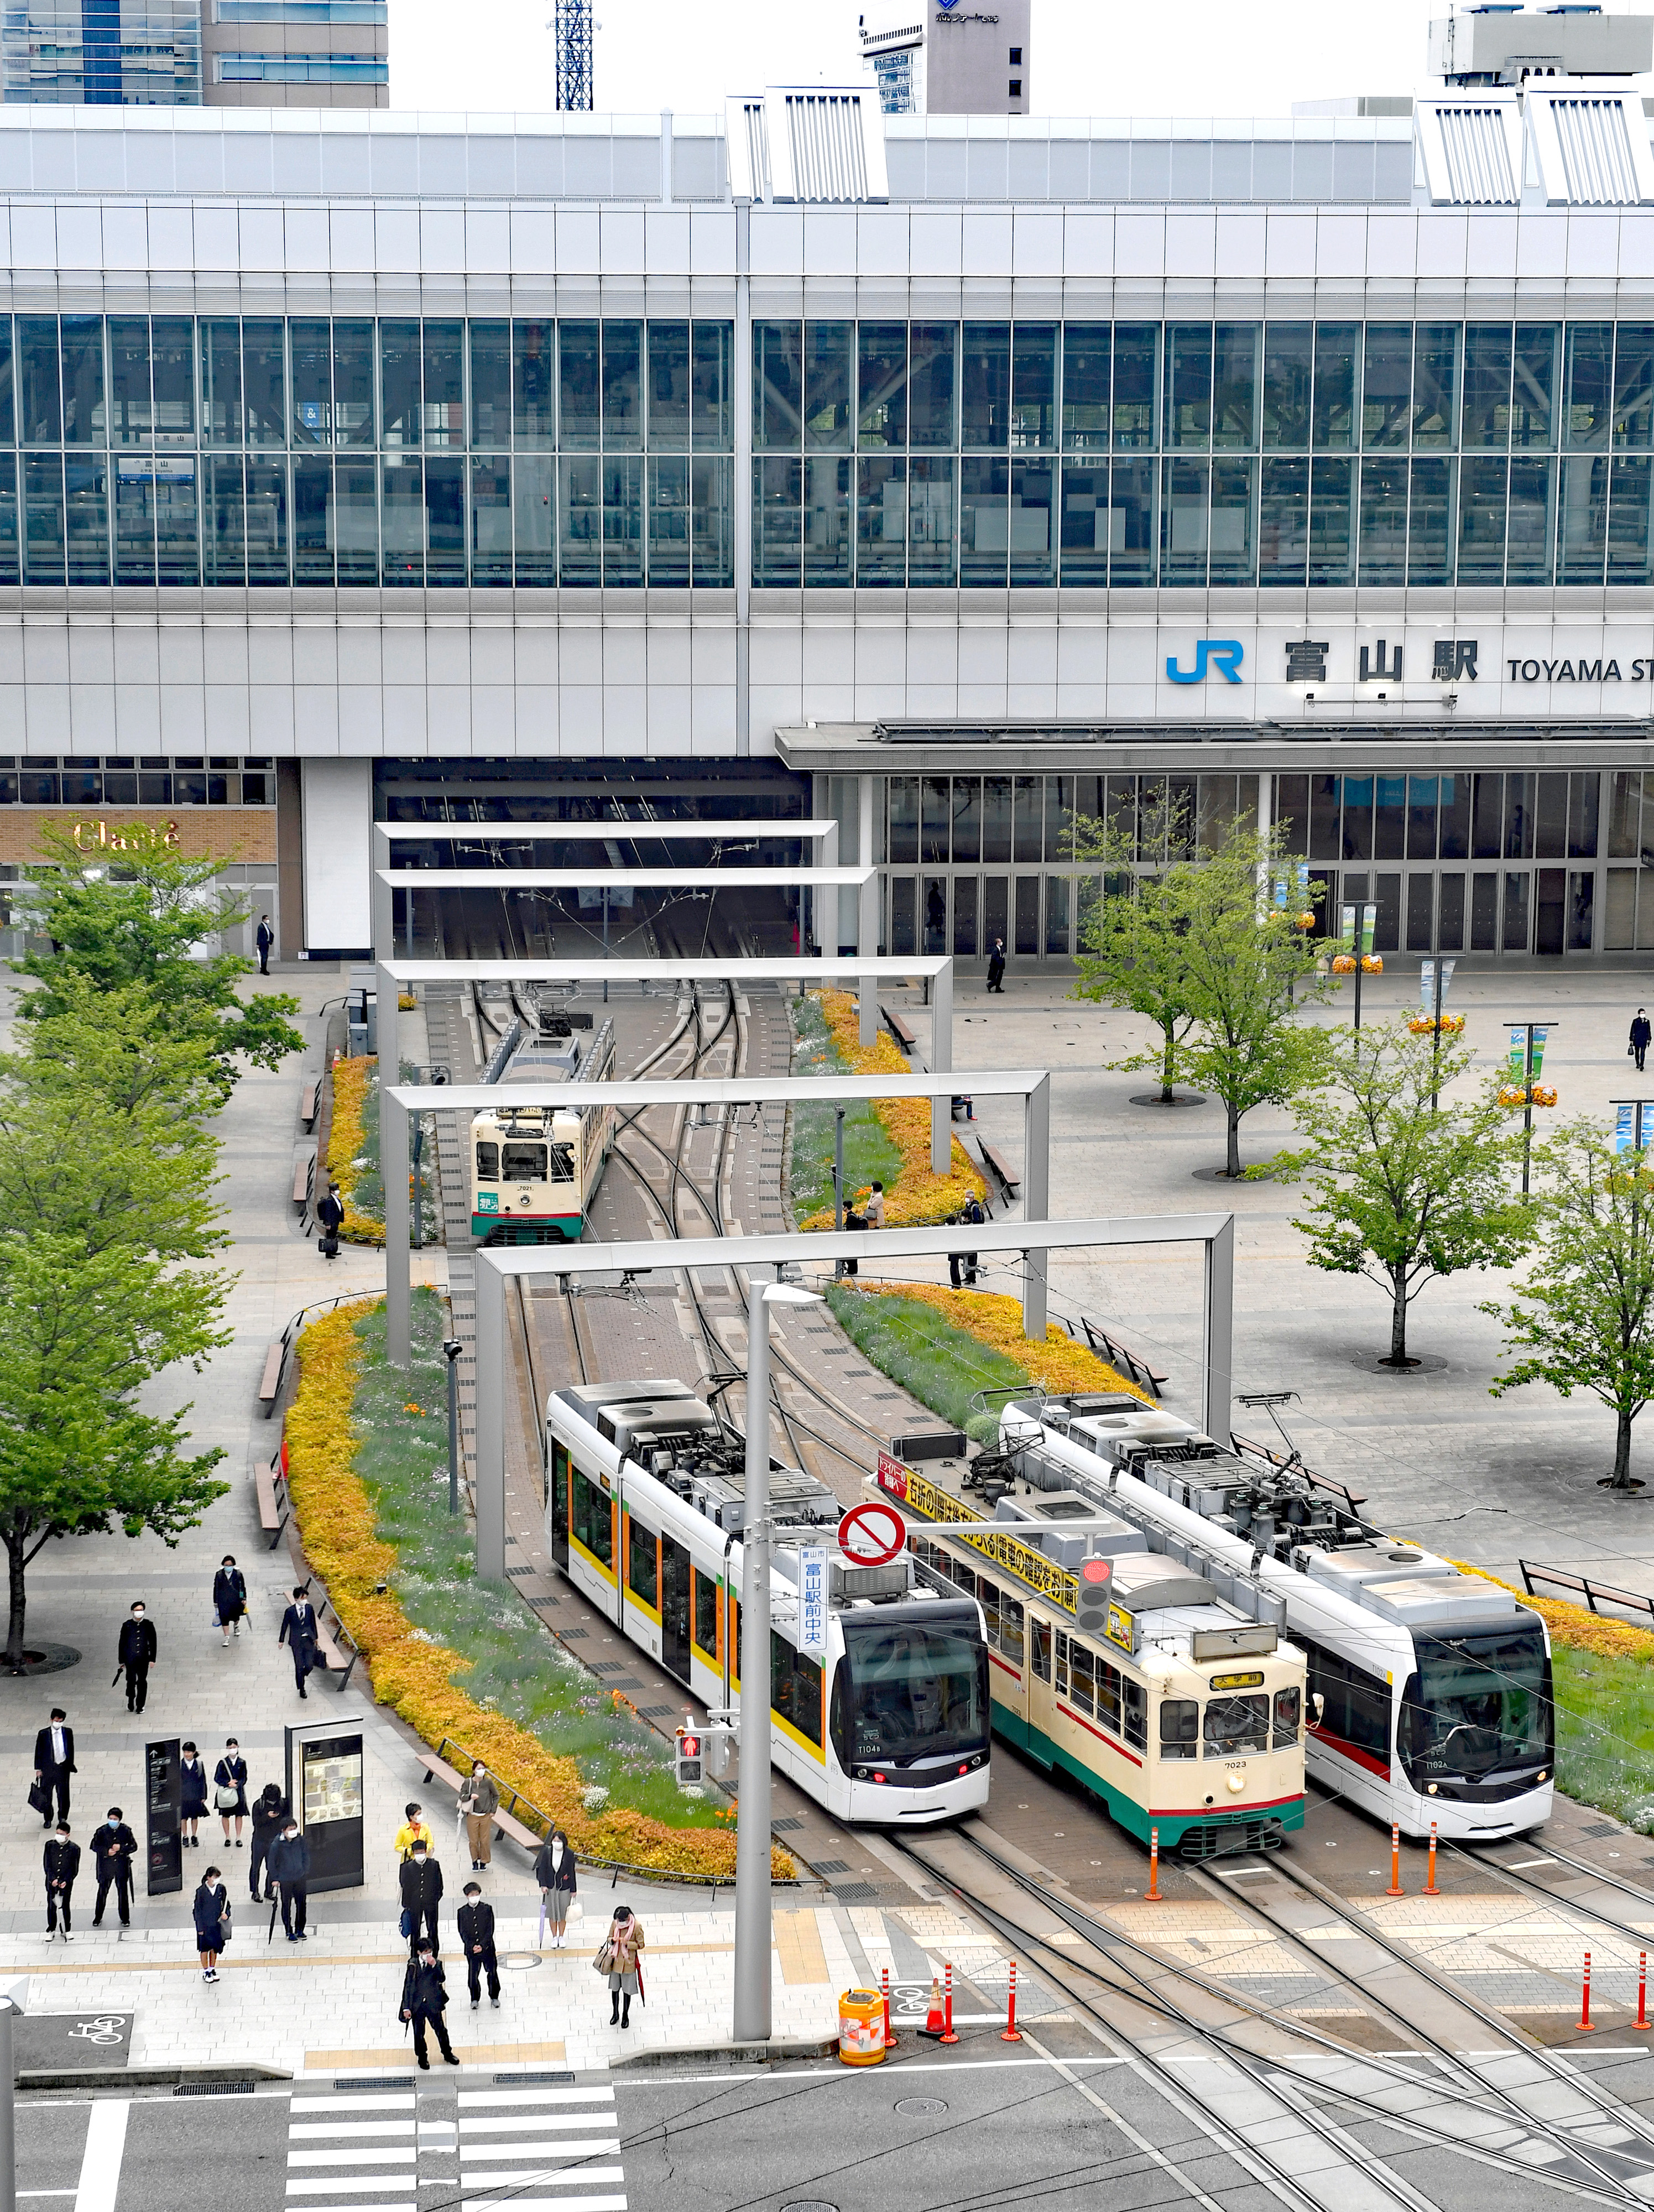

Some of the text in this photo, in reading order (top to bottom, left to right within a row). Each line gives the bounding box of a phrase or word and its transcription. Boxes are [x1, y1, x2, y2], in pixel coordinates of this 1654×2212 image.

[1167, 639, 1244, 684] JR
[1285, 639, 1479, 682] 富山駅
[1507, 659, 1622, 681] TOYAMA
[879, 1457, 906, 1483] ドライバーの
[884, 1472, 899, 1492] 皆様へ
[805, 1563, 821, 1646] 富山駅前中央
[1218, 1674, 1257, 1684] 大学前
[1372, 1664, 1386, 1679] T102A
[858, 1745, 881, 1754] T104B
